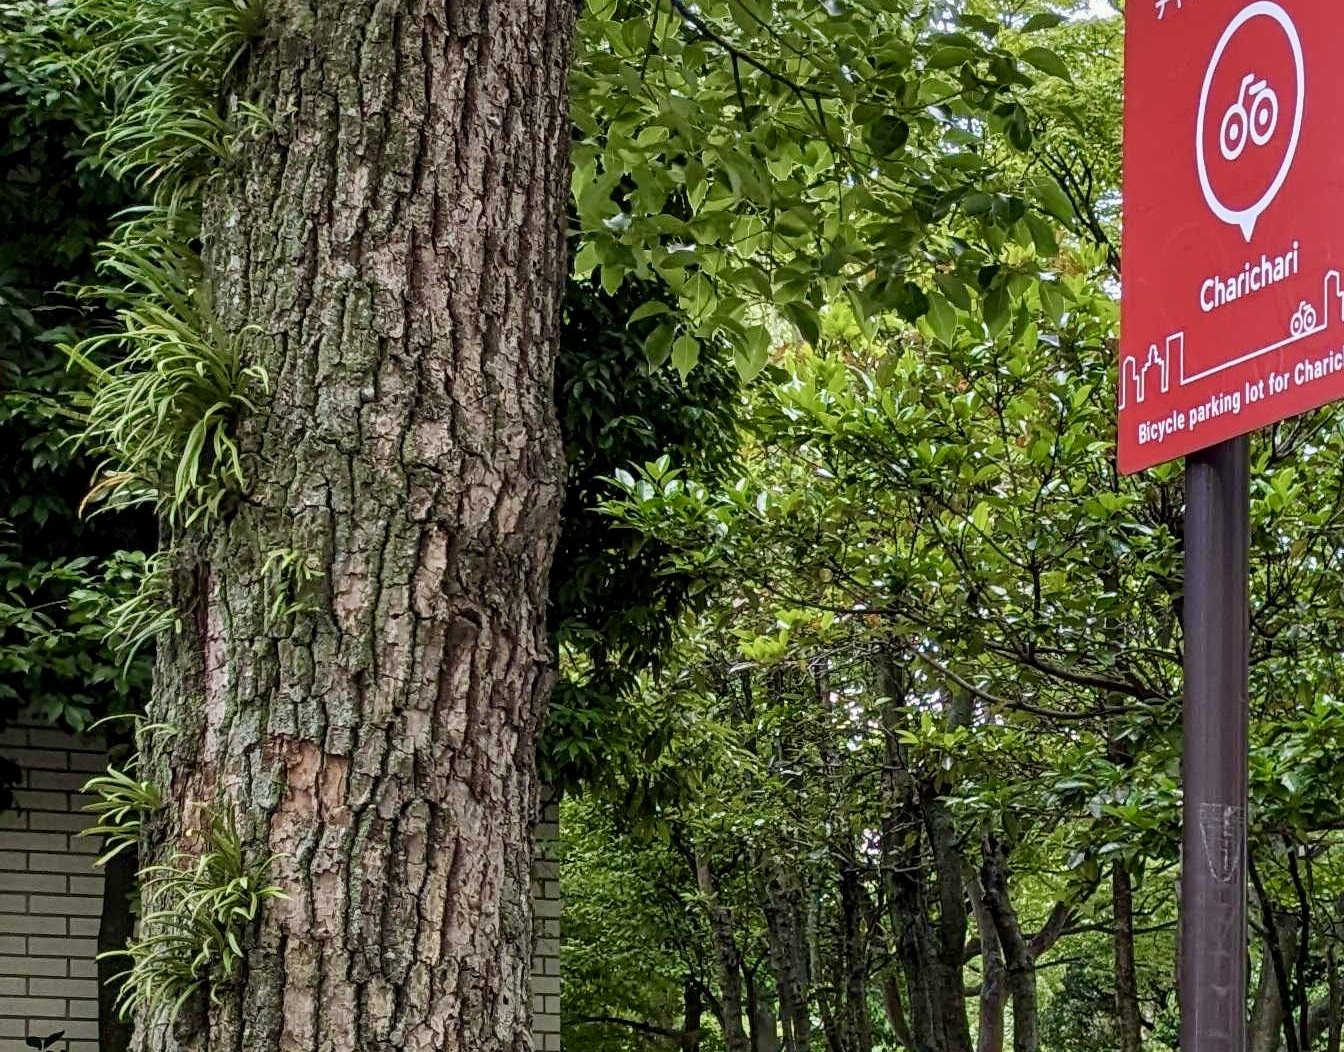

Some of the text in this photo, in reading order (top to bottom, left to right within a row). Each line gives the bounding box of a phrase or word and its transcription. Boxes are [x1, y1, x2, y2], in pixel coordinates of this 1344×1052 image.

[1199, 241, 1300, 313] Charichari
[1138, 410, 1185, 445] Bicycle
[1188, 389, 1241, 431] parking
[1245, 381, 1265, 405] lot
[1268, 371, 1290, 394] for
